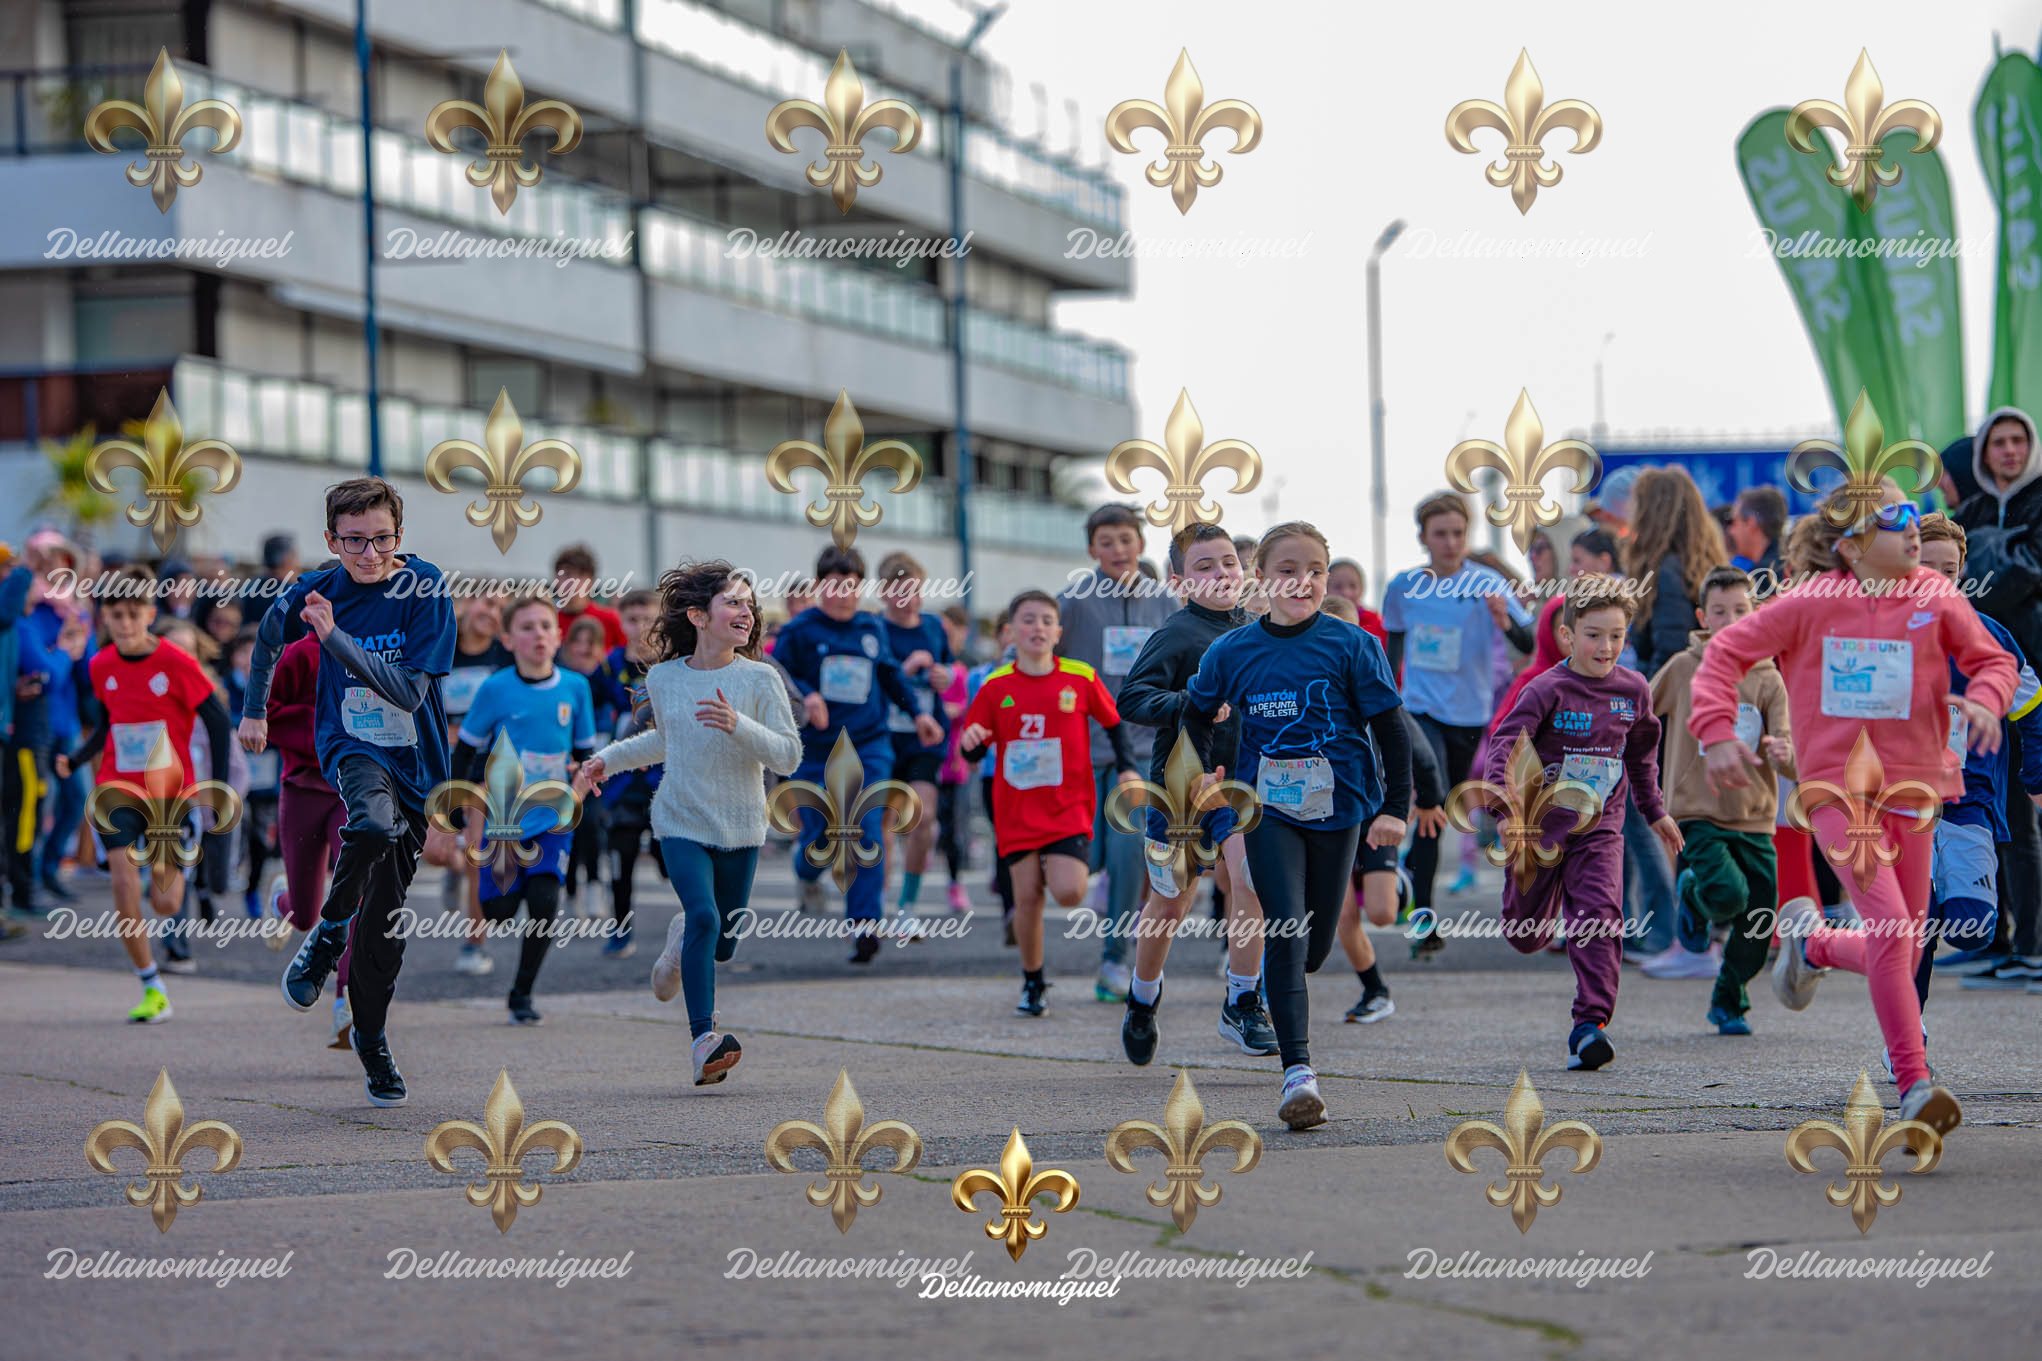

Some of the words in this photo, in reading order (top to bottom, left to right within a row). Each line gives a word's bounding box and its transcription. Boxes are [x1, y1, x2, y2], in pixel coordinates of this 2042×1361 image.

[1831, 641, 1865, 652] KIDS
[1868, 642, 1898, 653] RUN
[350, 688, 371, 698] KIDS
[1246, 689, 1297, 704] MARATÓN
[1258, 702, 1269, 711] DE
[1269, 700, 1298, 710] PUNTA
[1278, 707, 1299, 717] ESTE
[1554, 710, 1593, 721] START
[1020, 713, 1046, 739] 23
[1553, 720, 1592, 731] GAME
[1297, 759, 1319, 769] RUN
[1574, 757, 1598, 766] KIDS
